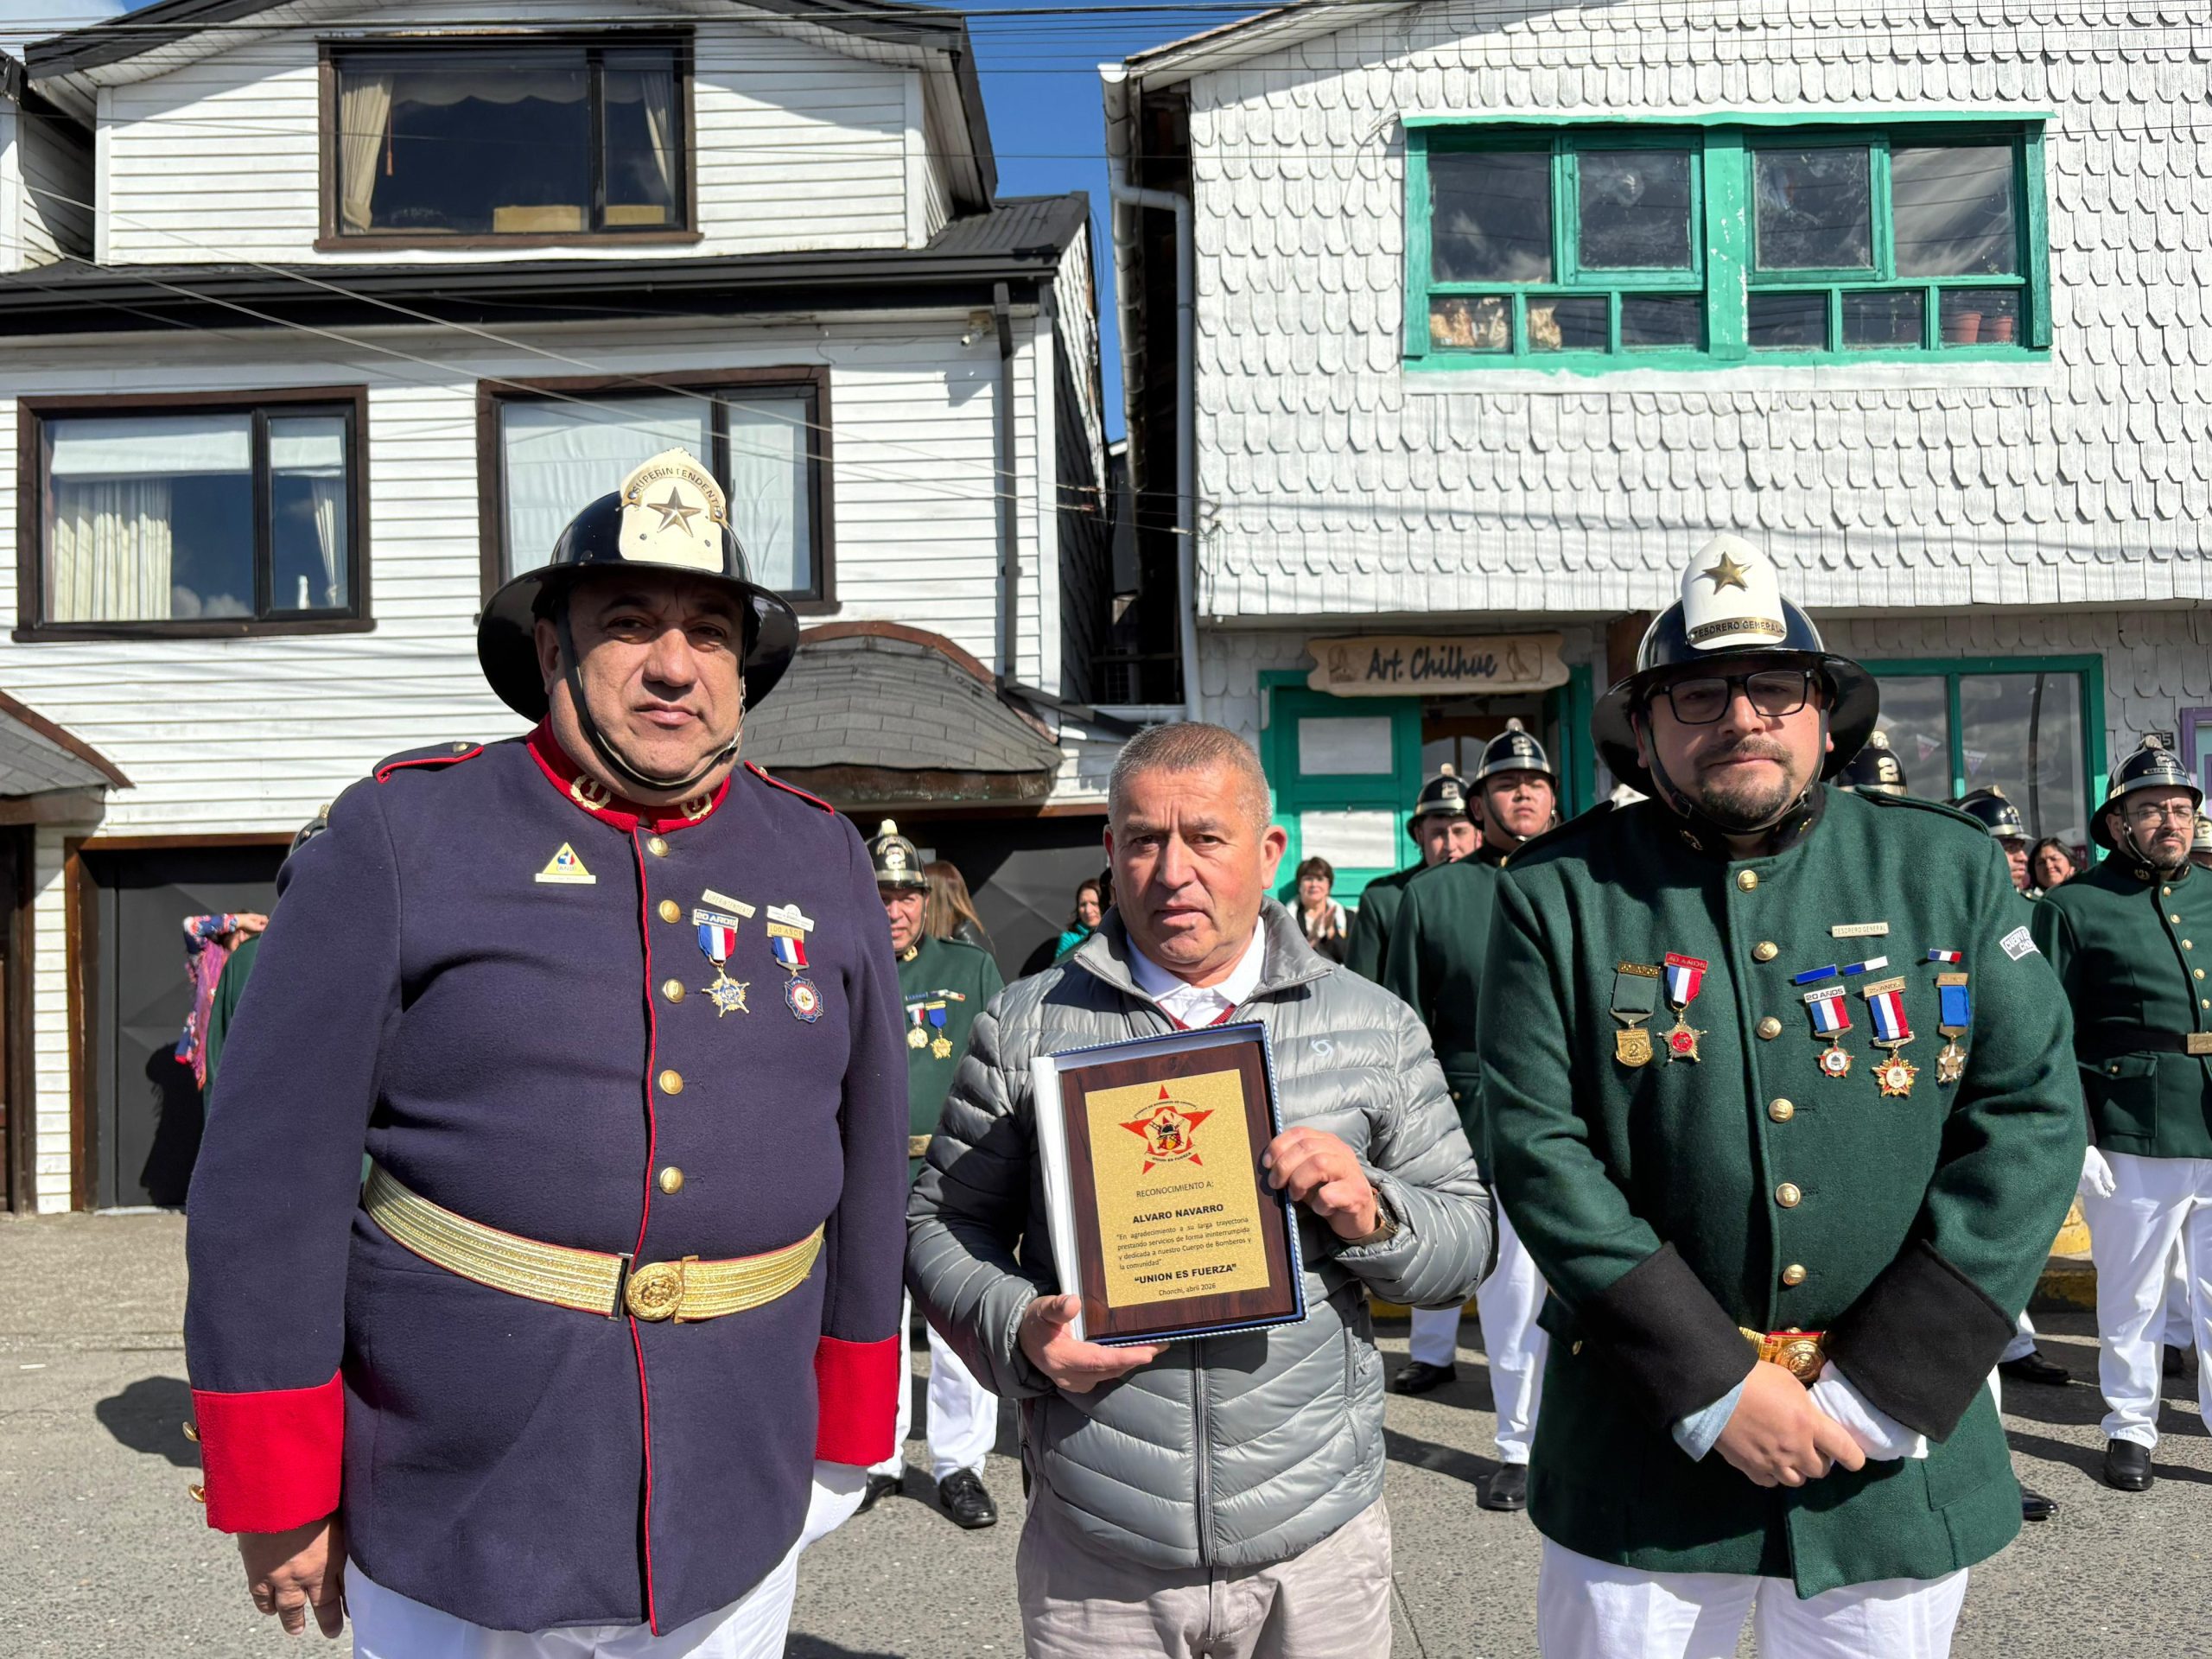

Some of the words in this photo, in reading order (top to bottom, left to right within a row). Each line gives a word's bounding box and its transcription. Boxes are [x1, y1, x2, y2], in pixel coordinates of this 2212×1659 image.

[1694, 621, 1739, 638] TESORERO
[1742, 620, 1781, 633] GENERAL
[1366, 647, 1403, 681] Art.
[1410, 645, 1498, 680] Chilhue
[1511, 736, 1533, 755] 2
[705, 893, 753, 916] SUPERINTENDENTE
[1834, 926, 1862, 935] TESORERO
[1862, 925, 1887, 933] GENERAL
[1806, 992, 1818, 1001] 20
[1136, 1181, 1204, 1198] RECONOCIMIENTO
[1133, 1211, 1173, 1224] ALVARO
[1175, 1204, 1224, 1217] NAVARRO
[1131, 1228, 1176, 1240] agradecimiento
[1217, 1217, 1249, 1227] trayectoria
[1117, 1242, 1147, 1251] prestando
[1148, 1237, 1174, 1246] servicios
[1205, 1227, 1250, 1238] ininterrumpida
[1124, 1251, 1150, 1260] dedicada
[1182, 1244, 1204, 1253] Cuerpo
[1215, 1237, 1245, 1247] Bomberos
[1176, 1270, 1189, 1279] ES
[1159, 1287, 1185, 1296] Chonchi,
[1185, 1284, 1199, 1293] abril
[1201, 1282, 1216, 1291] 2026
